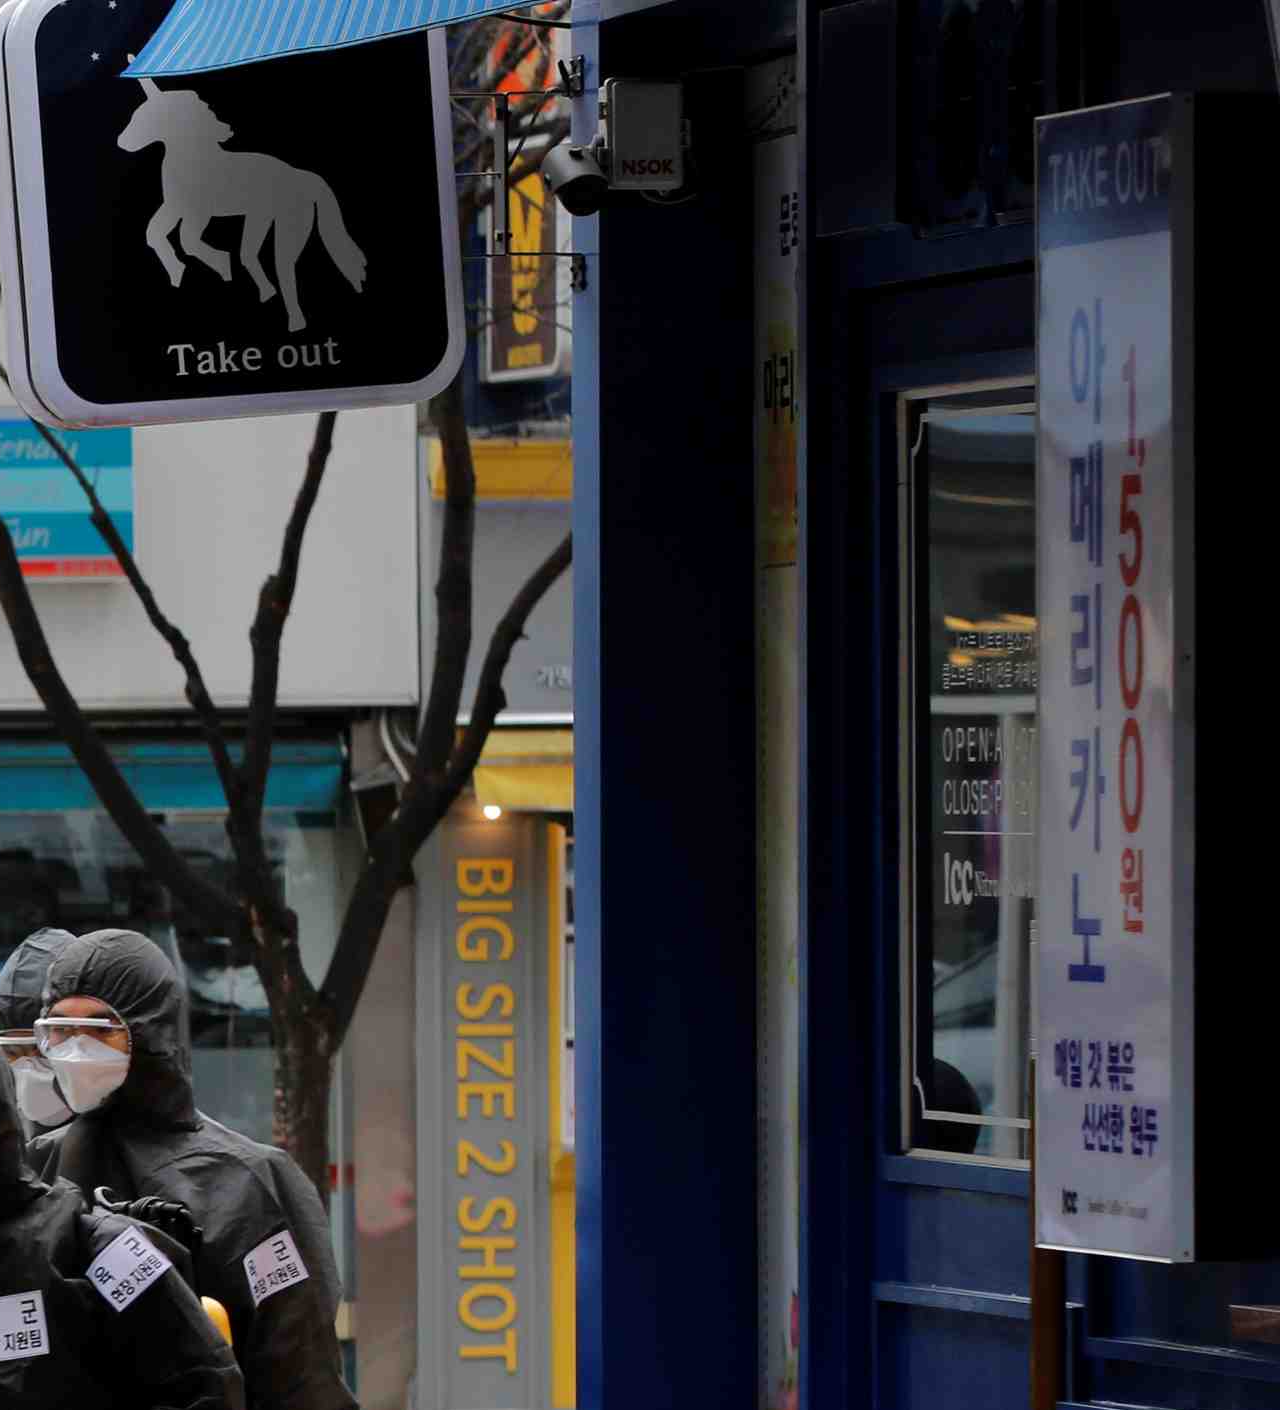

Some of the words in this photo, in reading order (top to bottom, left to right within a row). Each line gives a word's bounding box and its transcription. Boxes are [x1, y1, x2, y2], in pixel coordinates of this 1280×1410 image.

[621, 158, 674, 176] NSOK
[1048, 146, 1109, 212] TAKE
[1116, 138, 1163, 204] OUT
[167, 343, 262, 377] Take
[277, 337, 340, 370] out
[1068, 298, 1106, 983] 아메리카노
[456, 857, 514, 962] BIG
[456, 983, 515, 1120] SIZE
[1082, 1103, 1124, 1154] 신선한
[1130, 1105, 1159, 1159] 원두
[456, 1140, 516, 1177] 2
[123, 1236, 146, 1259] 군
[457, 1196, 517, 1374] SHOT
[20, 1299, 38, 1325] 군
[3, 1328, 43, 1353] 지원팀
